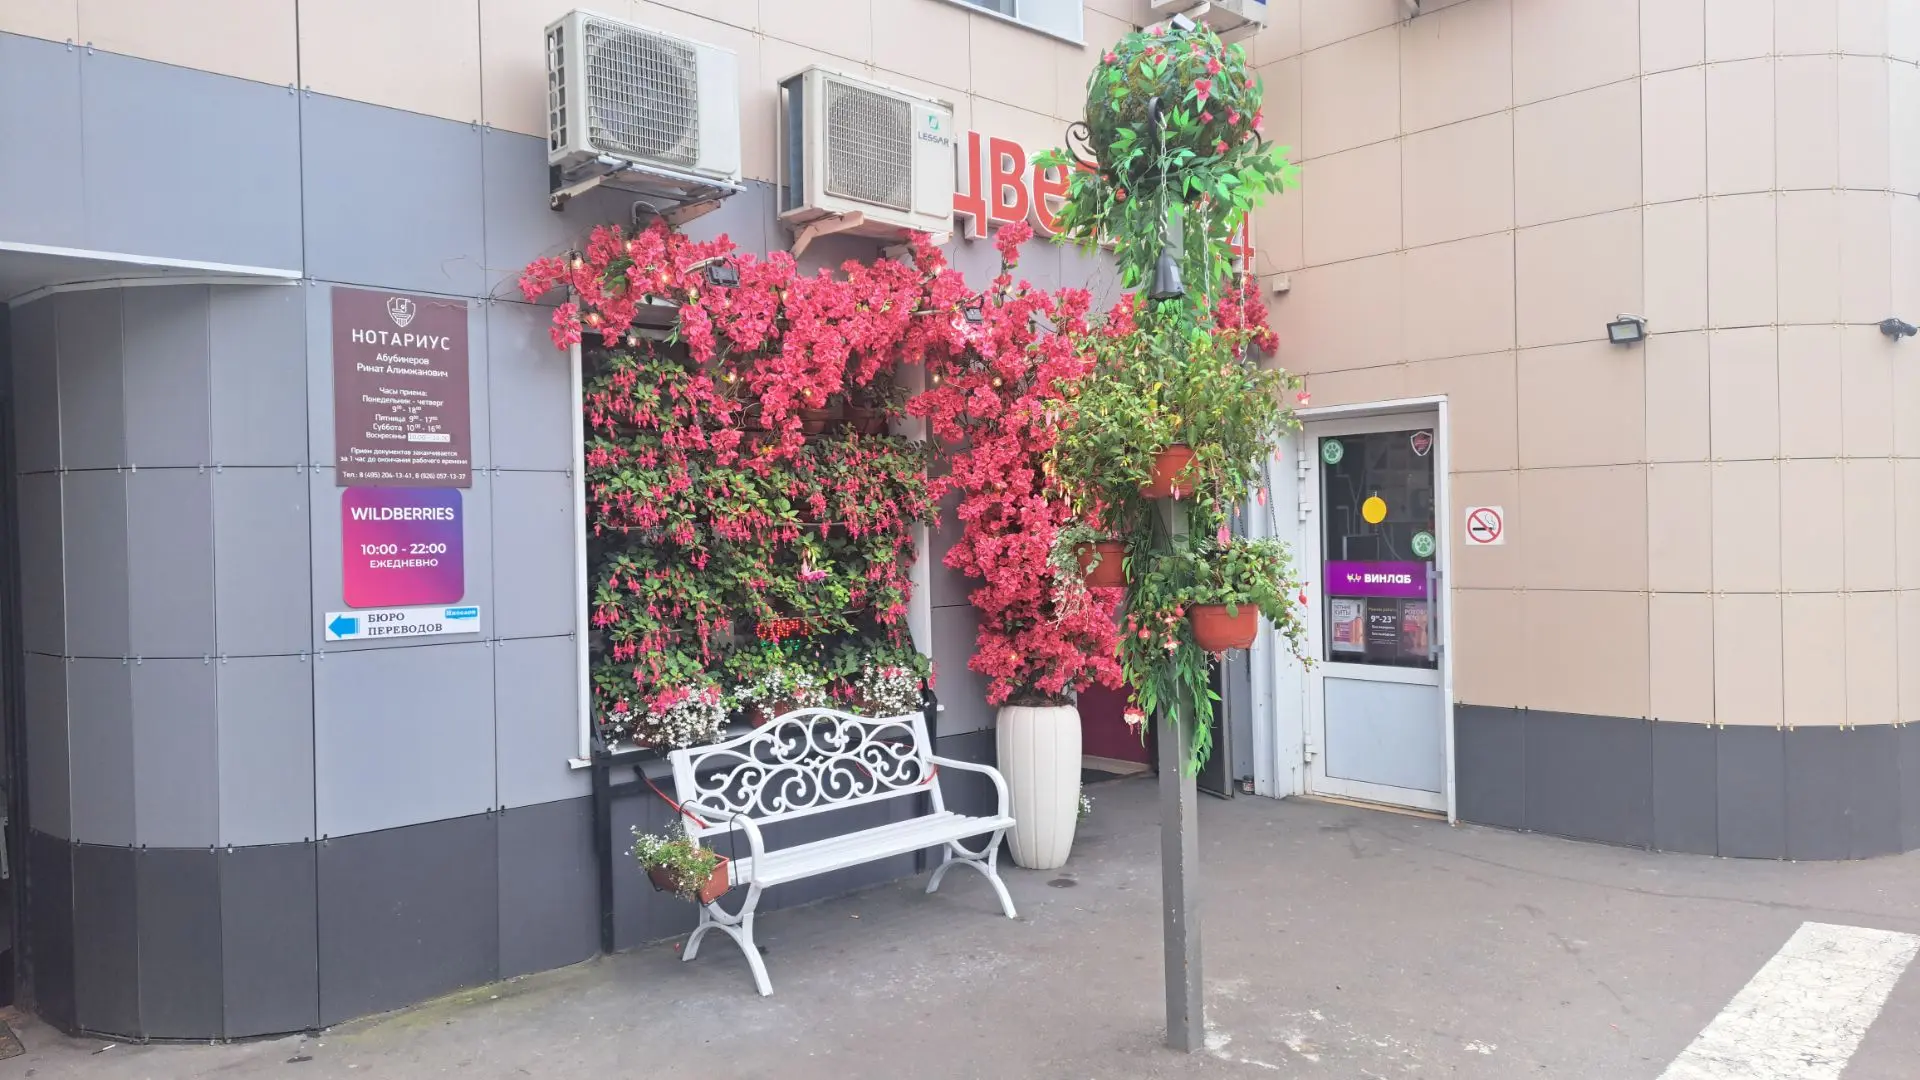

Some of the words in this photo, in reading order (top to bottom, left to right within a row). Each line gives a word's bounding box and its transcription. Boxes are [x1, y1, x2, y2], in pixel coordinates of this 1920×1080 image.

[917, 131, 950, 147] LESSAR
[352, 328, 450, 350] НОТАРИУС
[356, 362, 384, 374] Ринат
[386, 365, 448, 377] Алимжанович
[379, 387, 398, 395] Часы
[362, 395, 411, 405] Понедельник
[375, 414, 406, 422] Пятница
[373, 423, 403, 432] Суббота
[373, 449, 411, 457] документов
[351, 507, 455, 521] WILDBERRIES
[360, 543, 398, 555] 10:00
[409, 543, 447, 554] 22:00
[369, 559, 438, 569] ЕЖЕДНЕВНО
[368, 612, 405, 623] БЮРО
[368, 623, 443, 636] ПЕРЕВОДОВ
